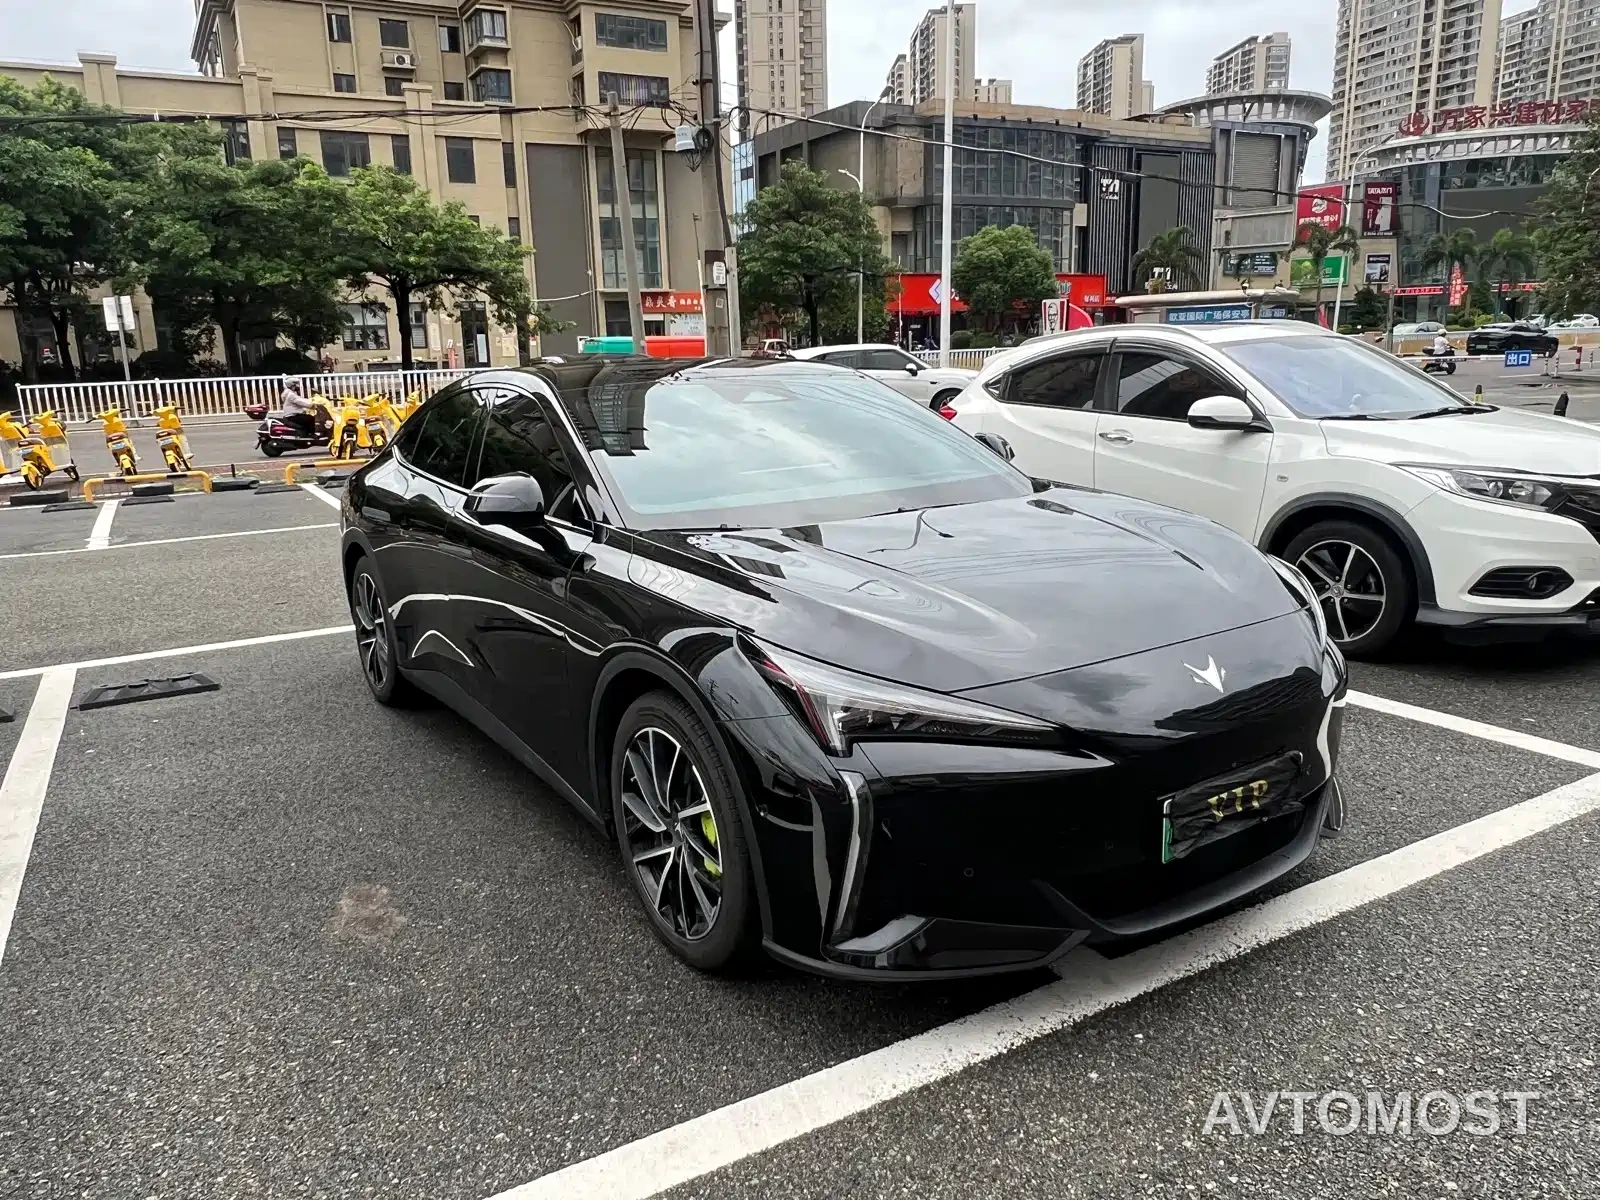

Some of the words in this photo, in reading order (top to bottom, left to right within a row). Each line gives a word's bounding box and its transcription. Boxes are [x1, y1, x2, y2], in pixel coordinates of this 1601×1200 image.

[1168, 309, 1250, 321] 欧亚国际广场保安亭
[1506, 353, 1530, 365] 出口
[1207, 779, 1268, 823] VIP
